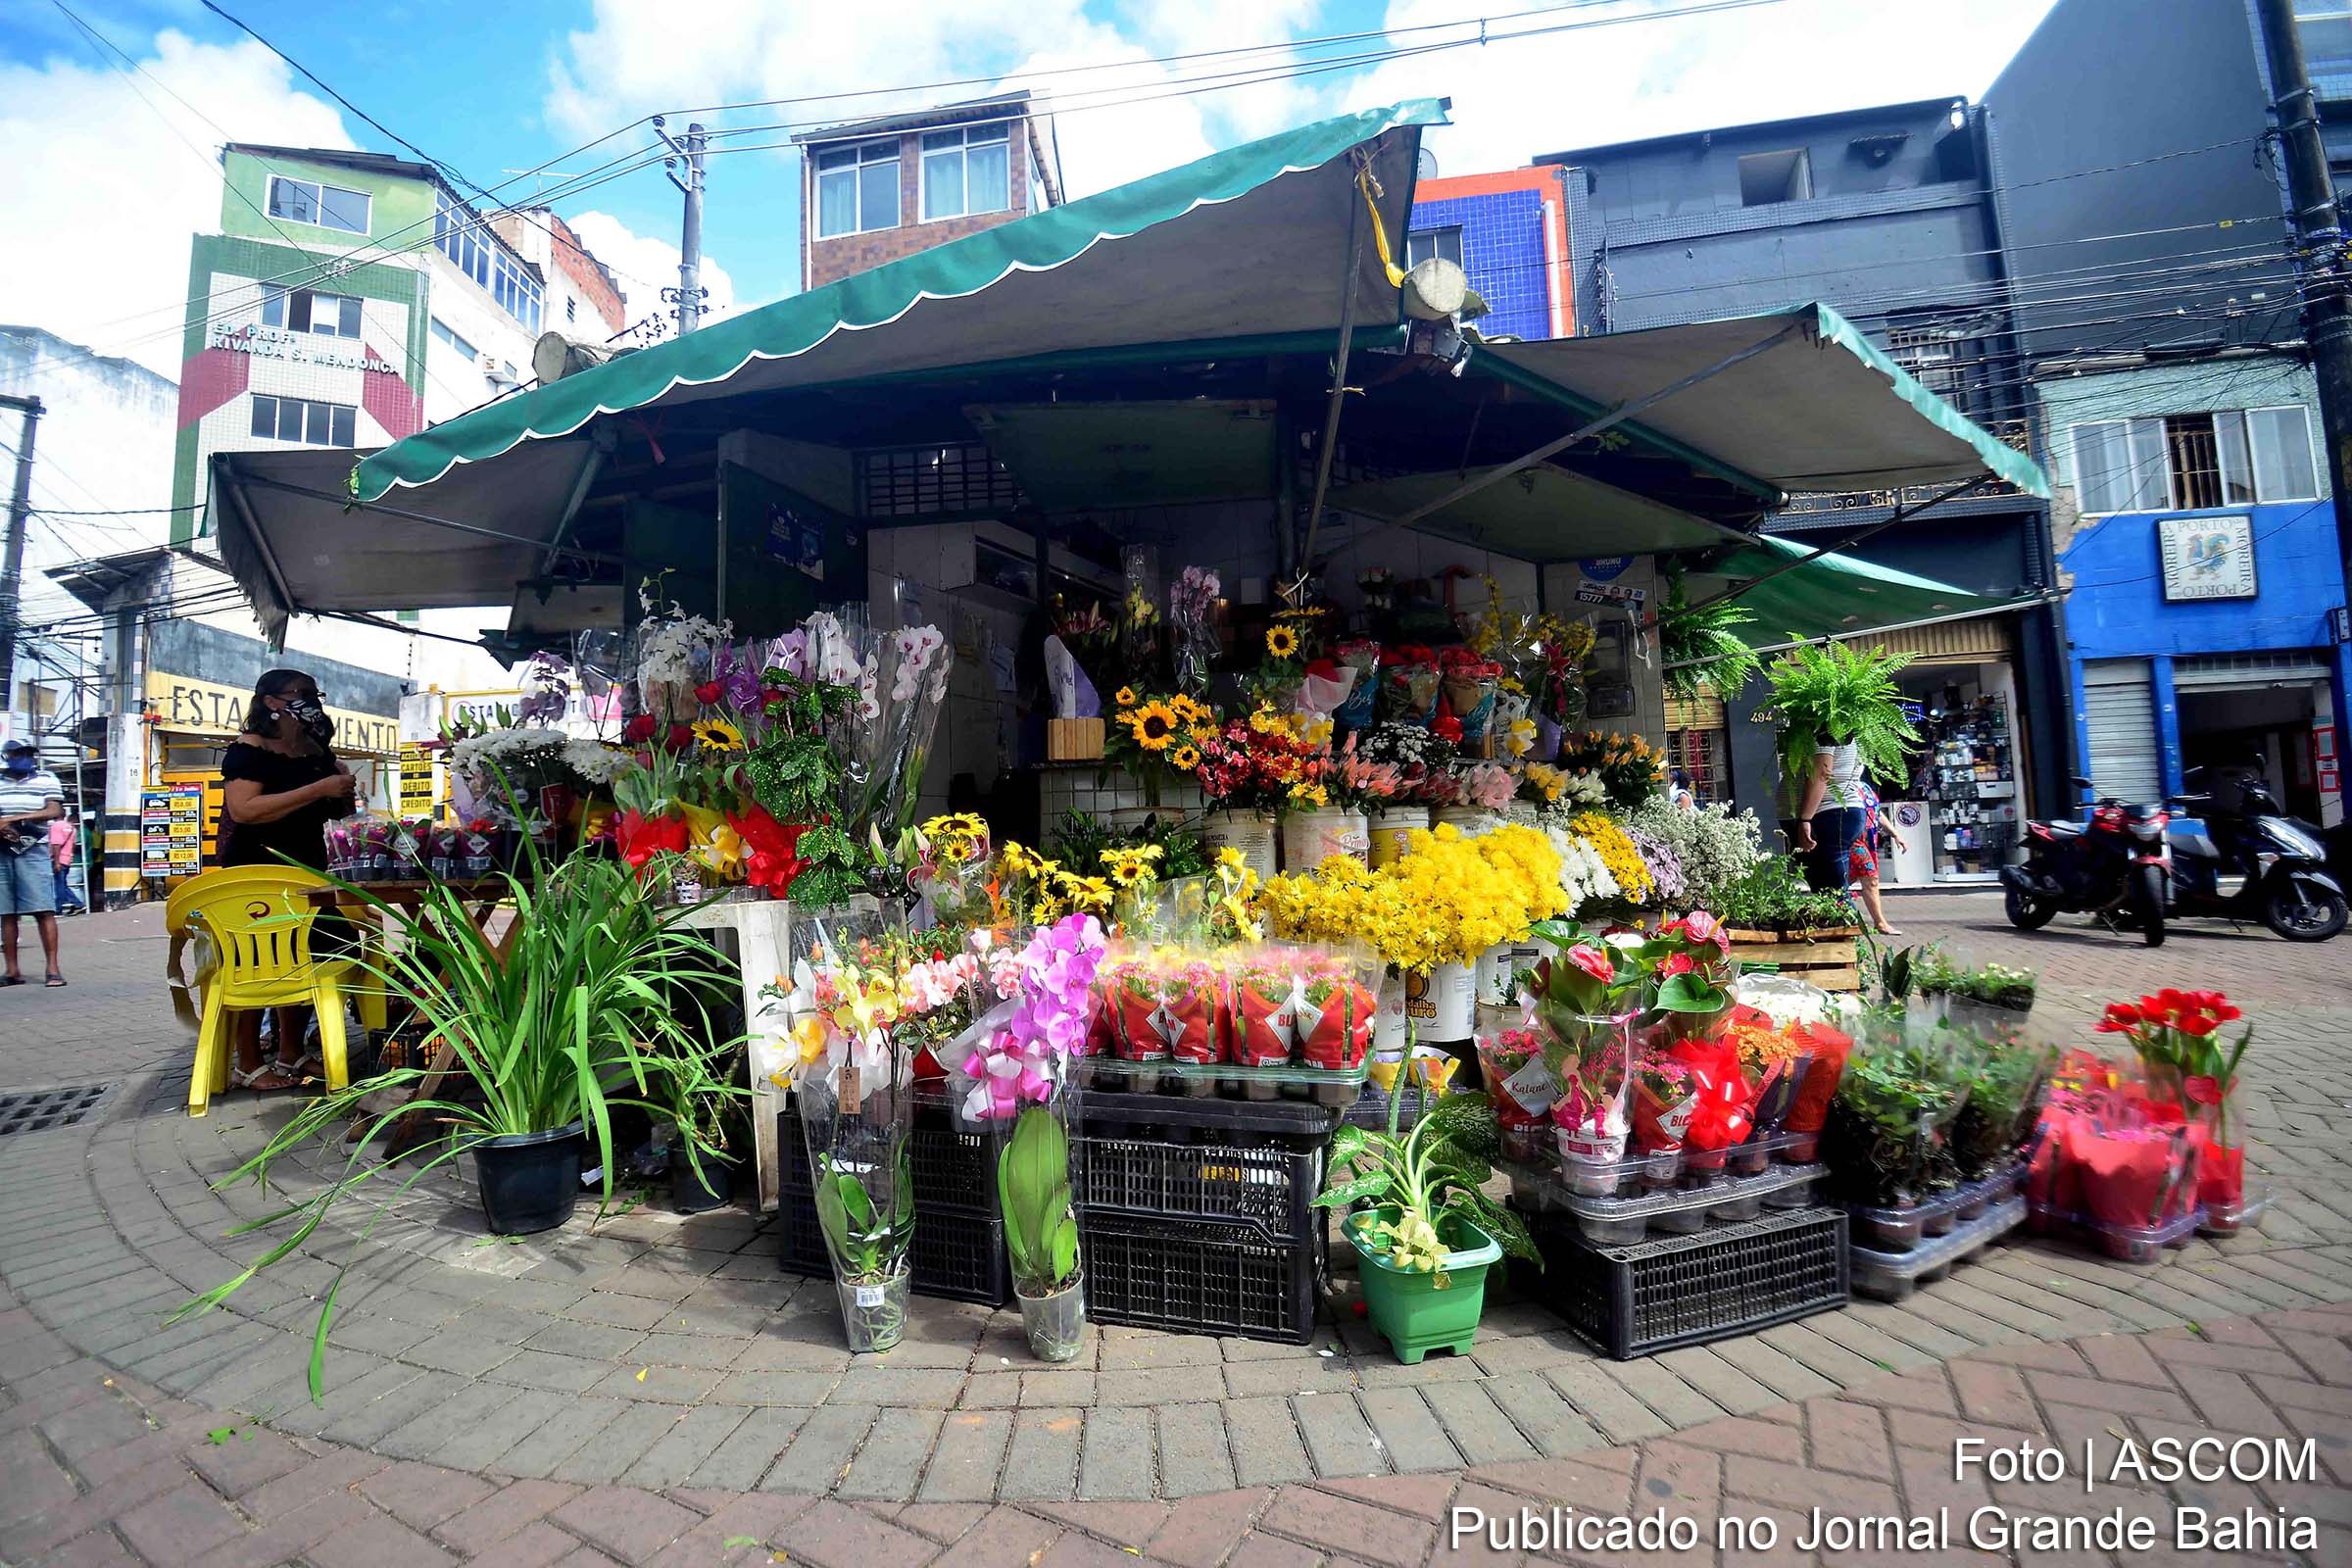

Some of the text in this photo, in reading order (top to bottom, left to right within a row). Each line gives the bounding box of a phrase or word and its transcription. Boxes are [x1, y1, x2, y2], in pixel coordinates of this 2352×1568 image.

[2178, 519, 2232, 533] PORTO
[2162, 522, 2180, 590] MOREIRA
[2235, 526, 2253, 594] MOREIRA
[2182, 584, 2238, 598] PORTO
[1750, 711, 1773, 723] 494
